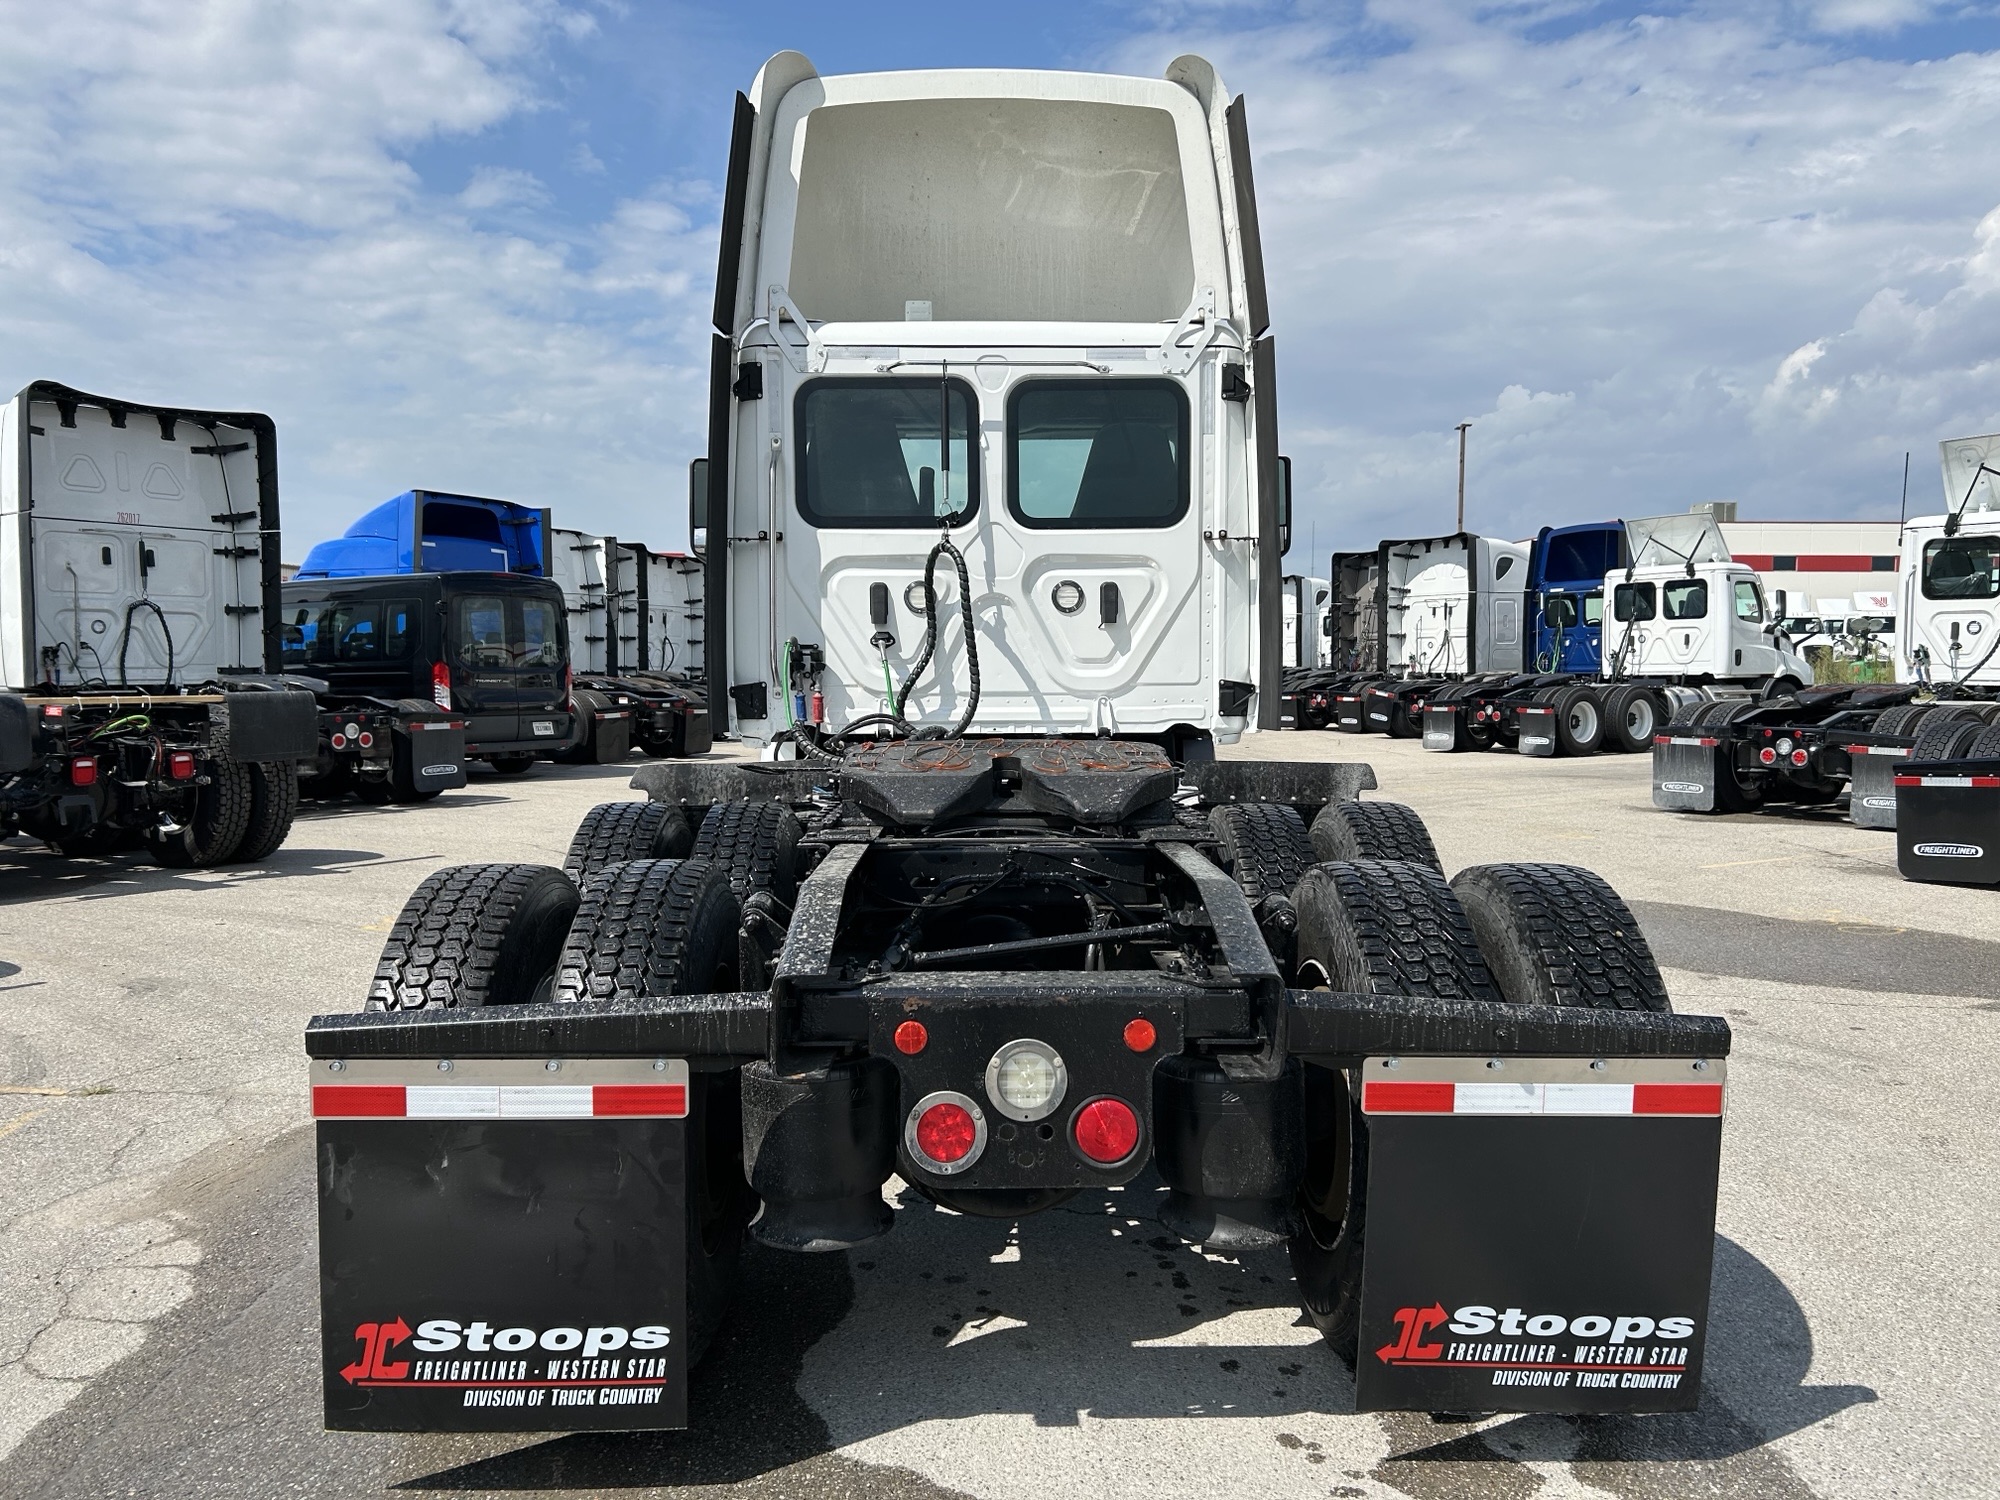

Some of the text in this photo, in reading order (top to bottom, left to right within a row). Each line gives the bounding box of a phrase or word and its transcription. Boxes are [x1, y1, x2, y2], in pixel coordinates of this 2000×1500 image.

[117, 512, 140, 524] 262017
[1665, 783, 1700, 792] FREIGHTLINER
[1919, 845, 1977, 855] FREIGHTLINER
[1448, 1305, 1696, 1344] Stoops
[412, 1320, 671, 1357] Stoops
[1447, 1342, 1555, 1363] FREIGHTLINER
[1574, 1345, 1645, 1365] WESTERN
[1649, 1346, 1688, 1366] STAR
[414, 1360, 527, 1381] FREIGHTLINER
[547, 1359, 620, 1380] WESTERN
[626, 1358, 667, 1379] STAR
[1492, 1370, 1682, 1389] DIVISION OF TRUCK COUNTRY
[463, 1387, 663, 1407] DIVISION OF TRUCK COUNTRY
